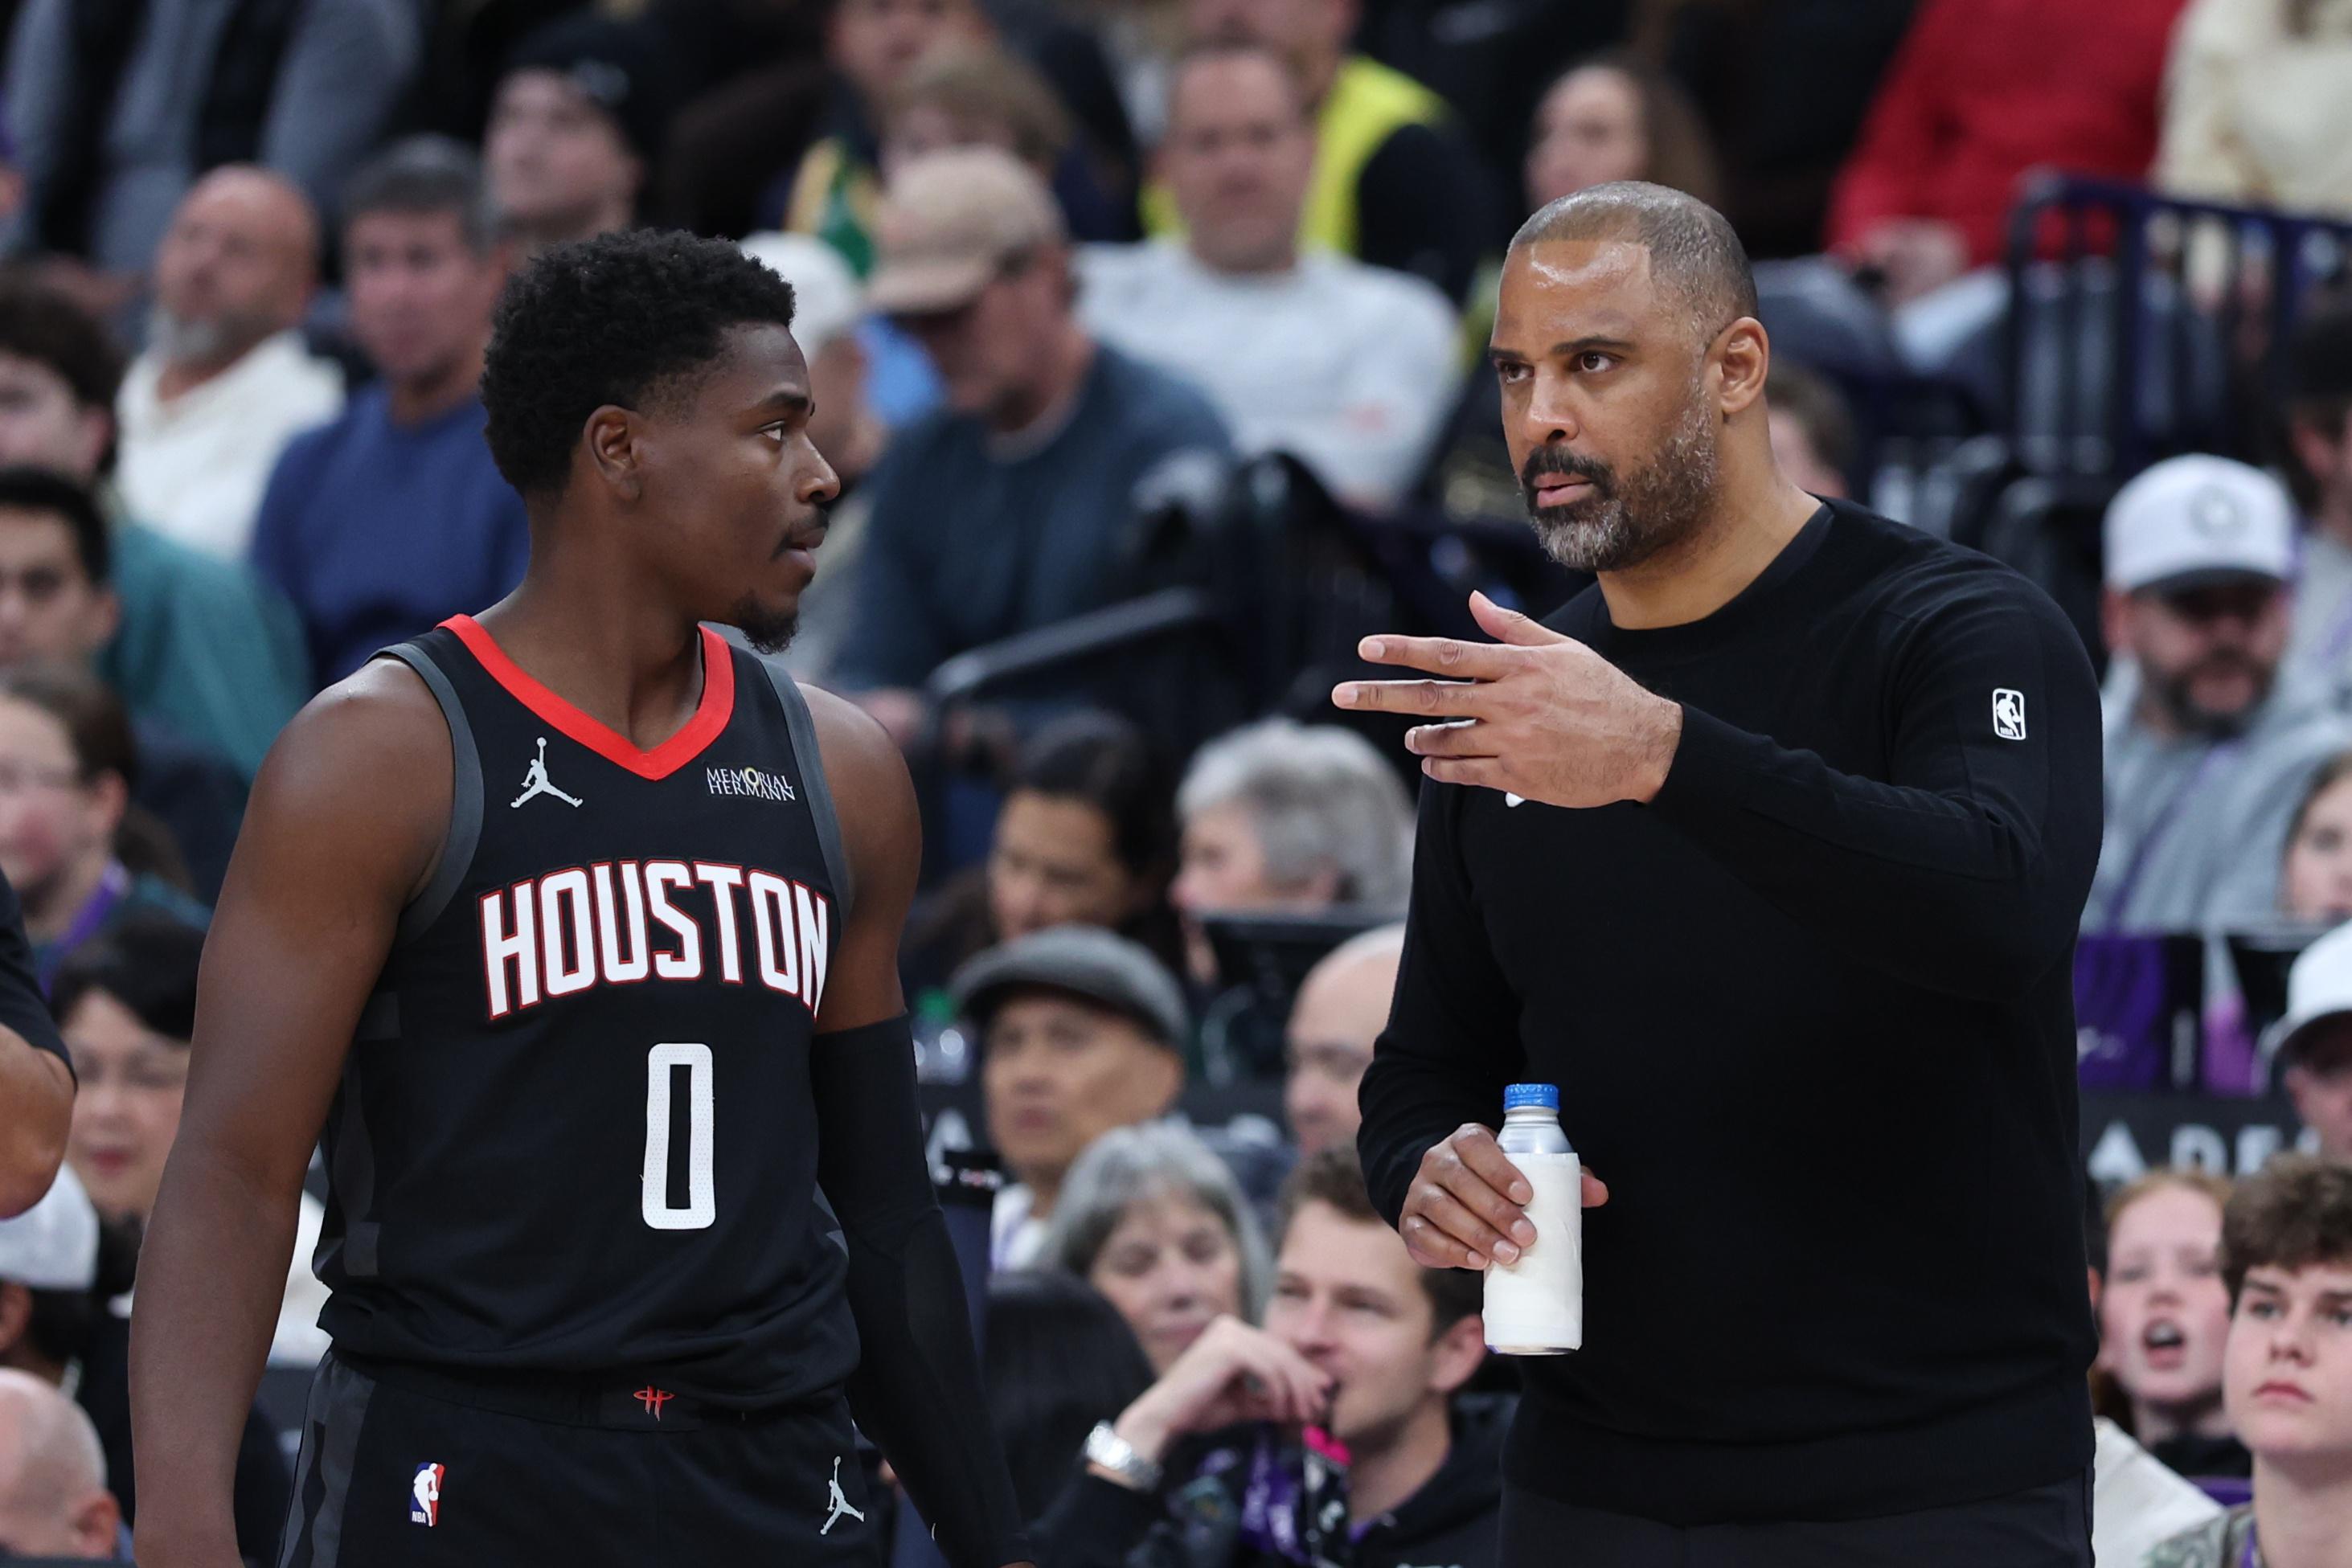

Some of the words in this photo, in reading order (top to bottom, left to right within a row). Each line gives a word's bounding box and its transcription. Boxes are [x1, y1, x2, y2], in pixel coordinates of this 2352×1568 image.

[707, 767, 793, 789] MEMORIAL
[707, 780, 796, 800] HERMANN
[480, 858, 830, 1021] HOUSTON
[642, 1043, 715, 1230] 0
[412, 1511, 426, 1523] NBA
